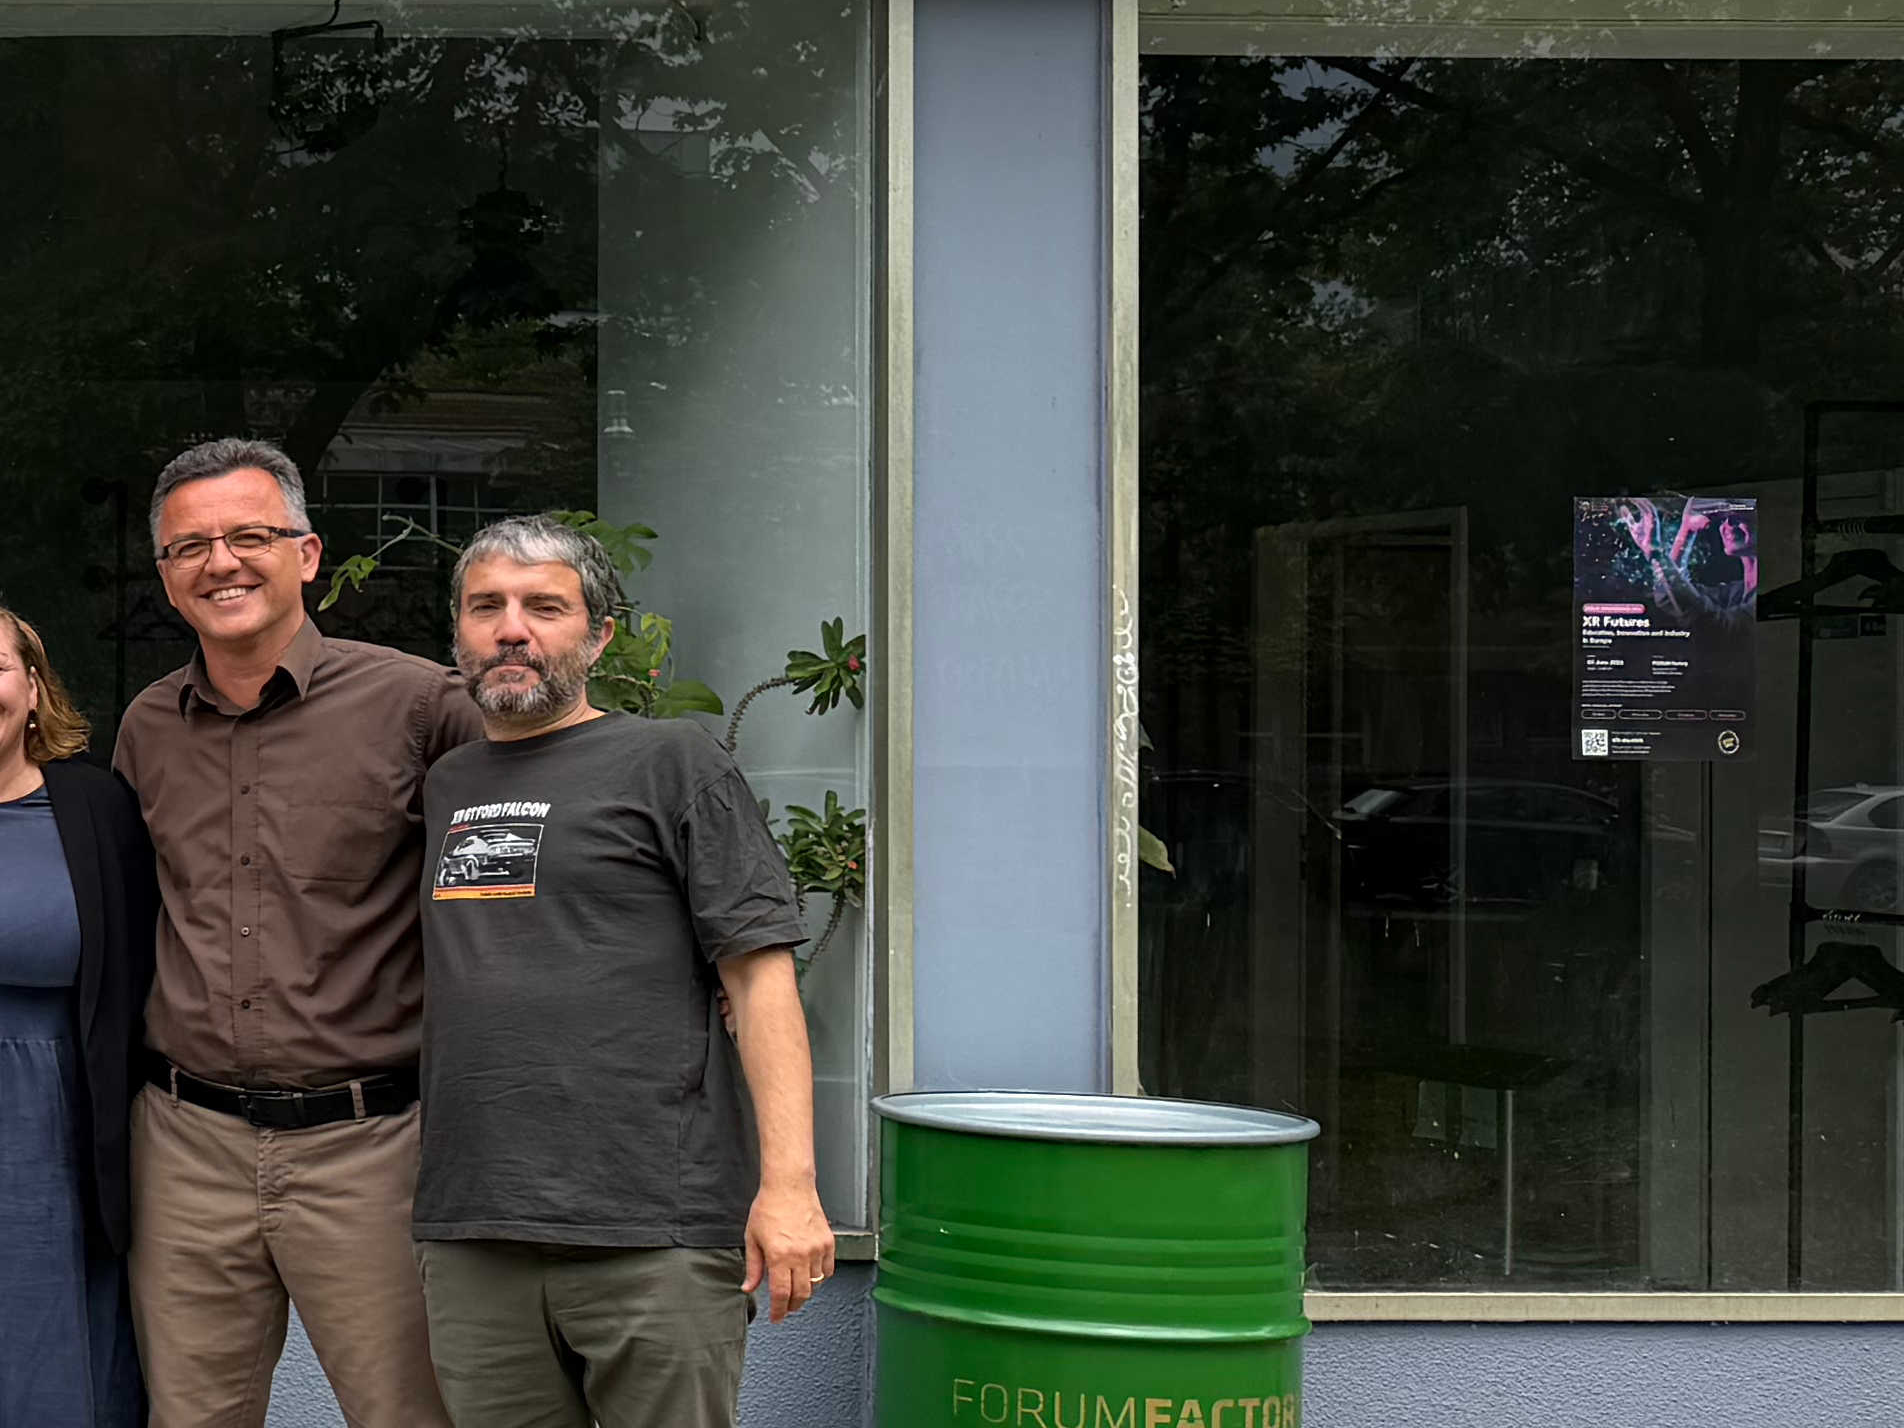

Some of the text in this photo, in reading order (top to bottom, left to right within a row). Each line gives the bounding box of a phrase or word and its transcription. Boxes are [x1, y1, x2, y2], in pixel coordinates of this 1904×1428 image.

[1582, 616, 1651, 627] XR Futures
[501, 801, 551, 818] FALCON
